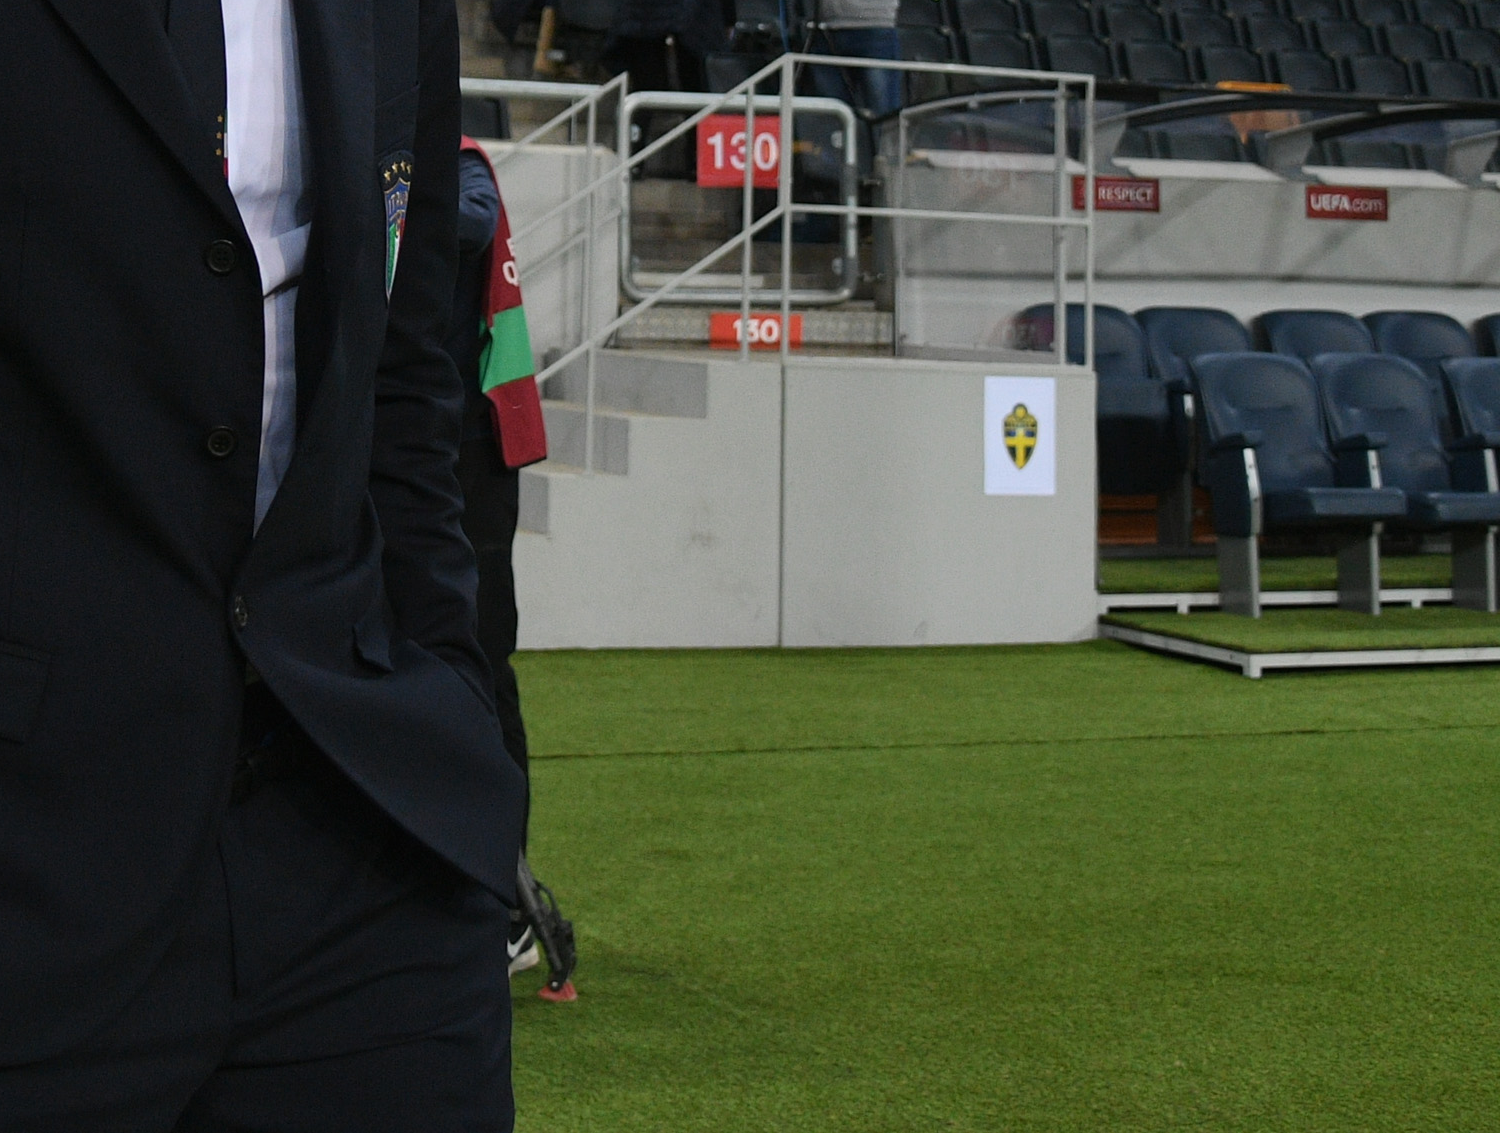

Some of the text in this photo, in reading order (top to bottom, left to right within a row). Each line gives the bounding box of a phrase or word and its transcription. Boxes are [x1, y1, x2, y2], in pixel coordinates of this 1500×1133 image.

[705, 131, 779, 171] 130
[1098, 185, 1153, 202] RESPECT
[1310, 192, 1385, 213] UEFA.com
[732, 318, 781, 345] 130
